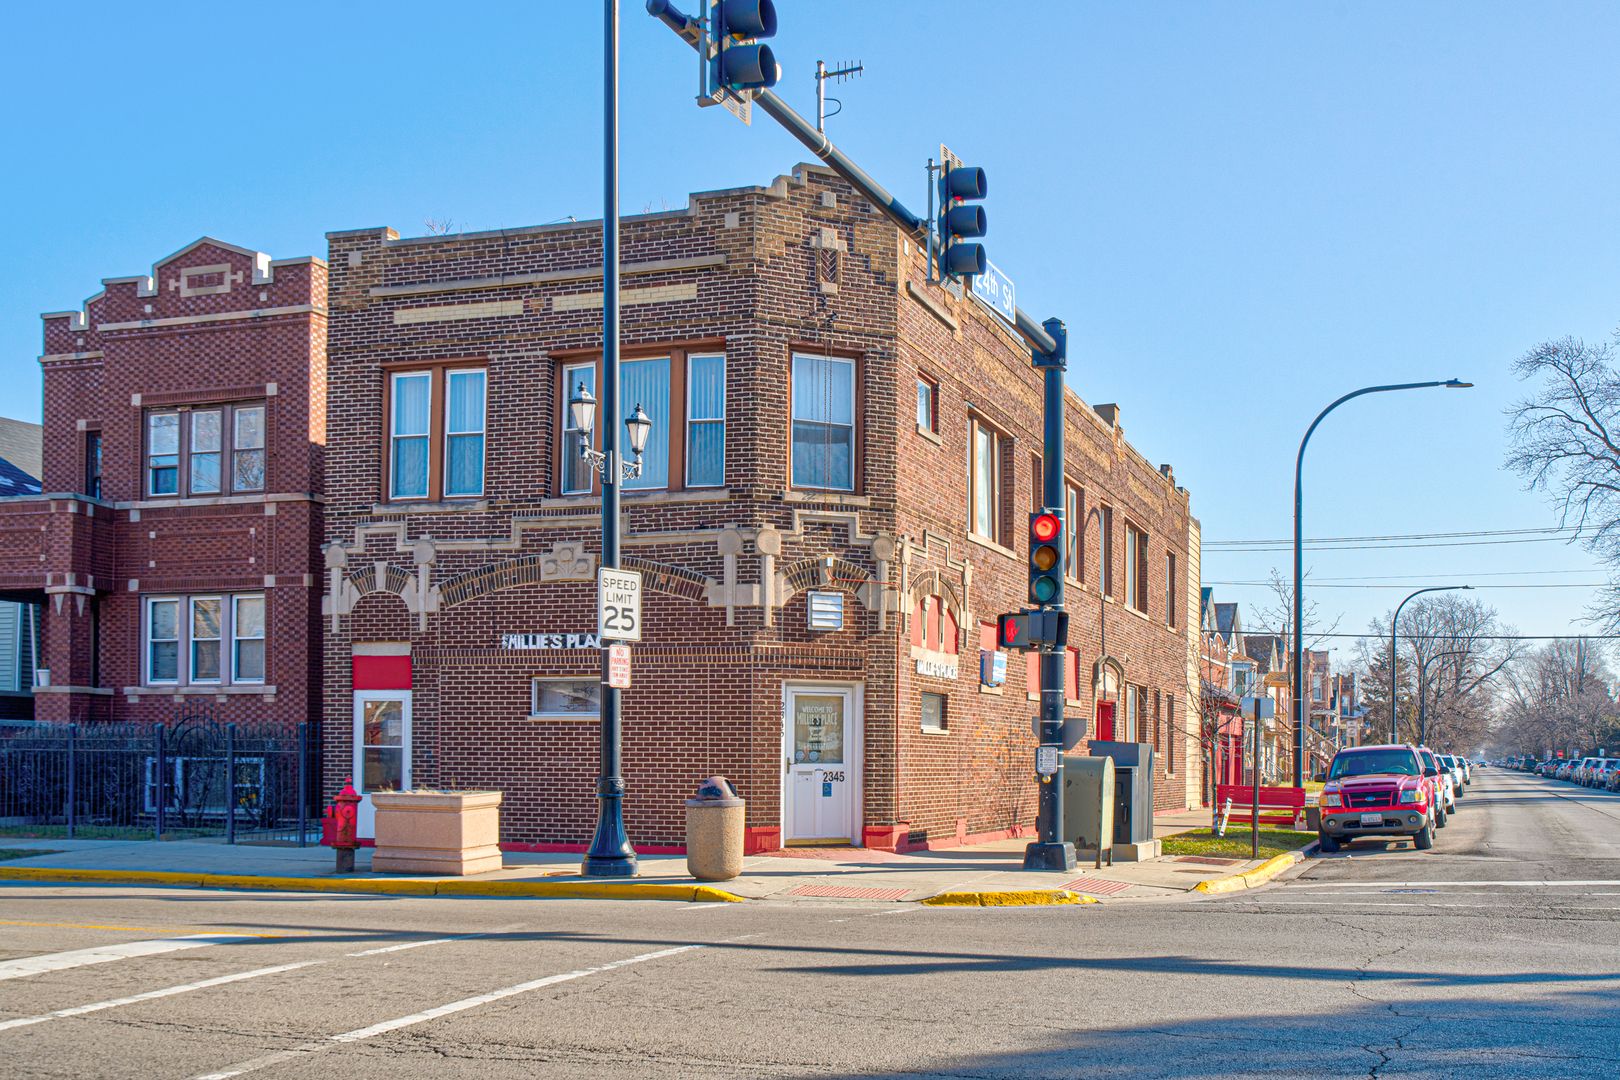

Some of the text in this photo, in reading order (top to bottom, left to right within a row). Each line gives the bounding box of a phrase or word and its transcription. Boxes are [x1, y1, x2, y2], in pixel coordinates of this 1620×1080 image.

[1002, 284, 1013, 314] St
[602, 577, 637, 592] SPEED
[605, 592, 633, 605] LIMIT
[603, 605, 635, 632] 25
[566, 634, 602, 649] PLAC
[615, 649, 625, 657] NO
[823, 771, 845, 783] 2345
